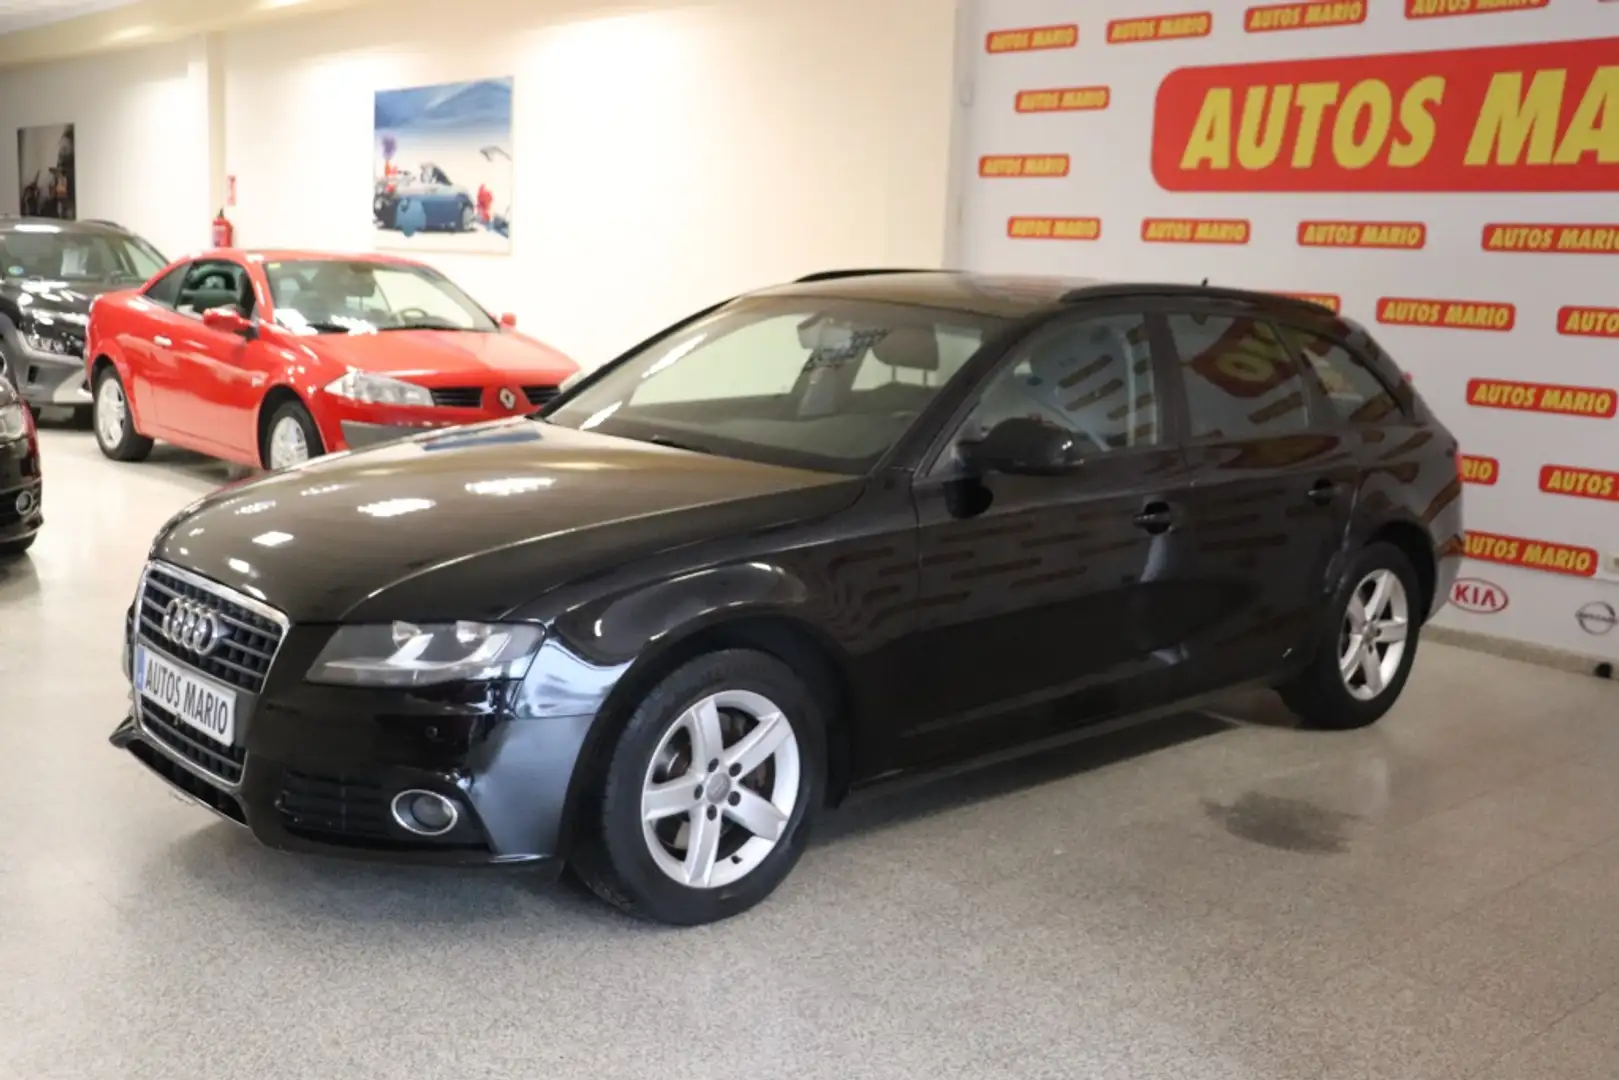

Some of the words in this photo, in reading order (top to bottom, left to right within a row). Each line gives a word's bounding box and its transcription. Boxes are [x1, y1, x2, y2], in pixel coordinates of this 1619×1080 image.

[1249, 7, 1302, 28] AUTOS
[1304, 1, 1362, 25] MARIO
[990, 32, 1029, 51] AUTOS
[1031, 28, 1075, 48] MARIO
[1111, 20, 1155, 41] AUTOS
[1158, 15, 1208, 37] MARIO
[1020, 91, 1060, 110] AUTOS
[1061, 88, 1107, 107] MARIO
[1180, 75, 1446, 169] AUTOS
[1463, 65, 1619, 165] MA
[983, 157, 1022, 175] AUTOS
[1024, 156, 1067, 174] MARIO
[1011, 218, 1051, 236] AUTOS
[1053, 218, 1098, 237] MARIO
[1146, 221, 1192, 240] AUTOS
[1194, 222, 1246, 241] MARIO
[1304, 225, 1358, 244] AUTOS
[1360, 226, 1421, 246] MARIO
[1488, 228, 1554, 249] AUTOS
[1382, 300, 1441, 323] AUTOS
[1444, 304, 1510, 328] MARIO
[1473, 383, 1537, 408] AUTOS
[1539, 388, 1613, 415] MARIO
[1547, 469, 1615, 495] AUTOS
[1521, 543, 1592, 572] MARIO
[1454, 583, 1497, 608] KIA
[146, 658, 182, 708] AUTOS
[183, 681, 229, 736] MARIO
